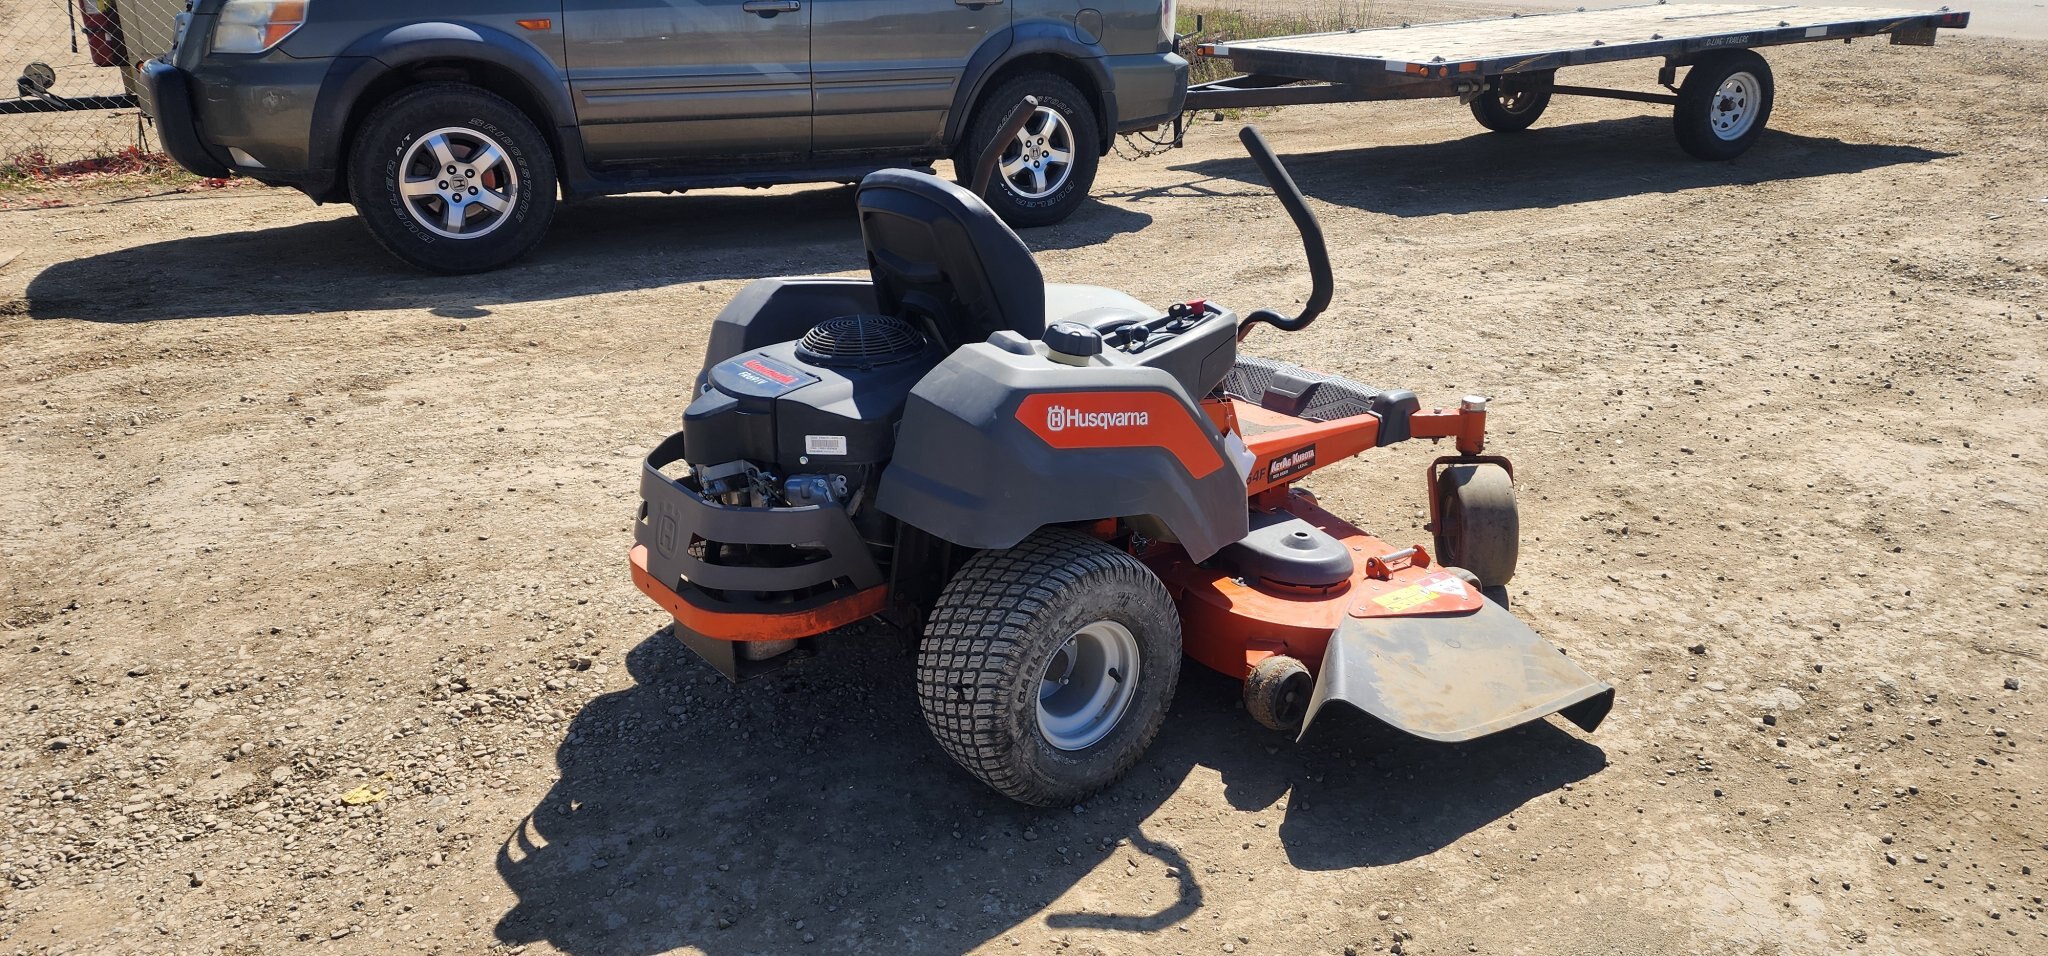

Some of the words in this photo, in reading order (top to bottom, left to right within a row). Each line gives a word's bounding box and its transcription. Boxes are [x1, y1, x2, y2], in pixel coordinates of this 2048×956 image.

[396, 132, 412, 156] A/T
[467, 117, 533, 223] BRIDGESTONE
[385, 159, 436, 244] DUELER
[1066, 408, 1149, 430] Husqvarna
